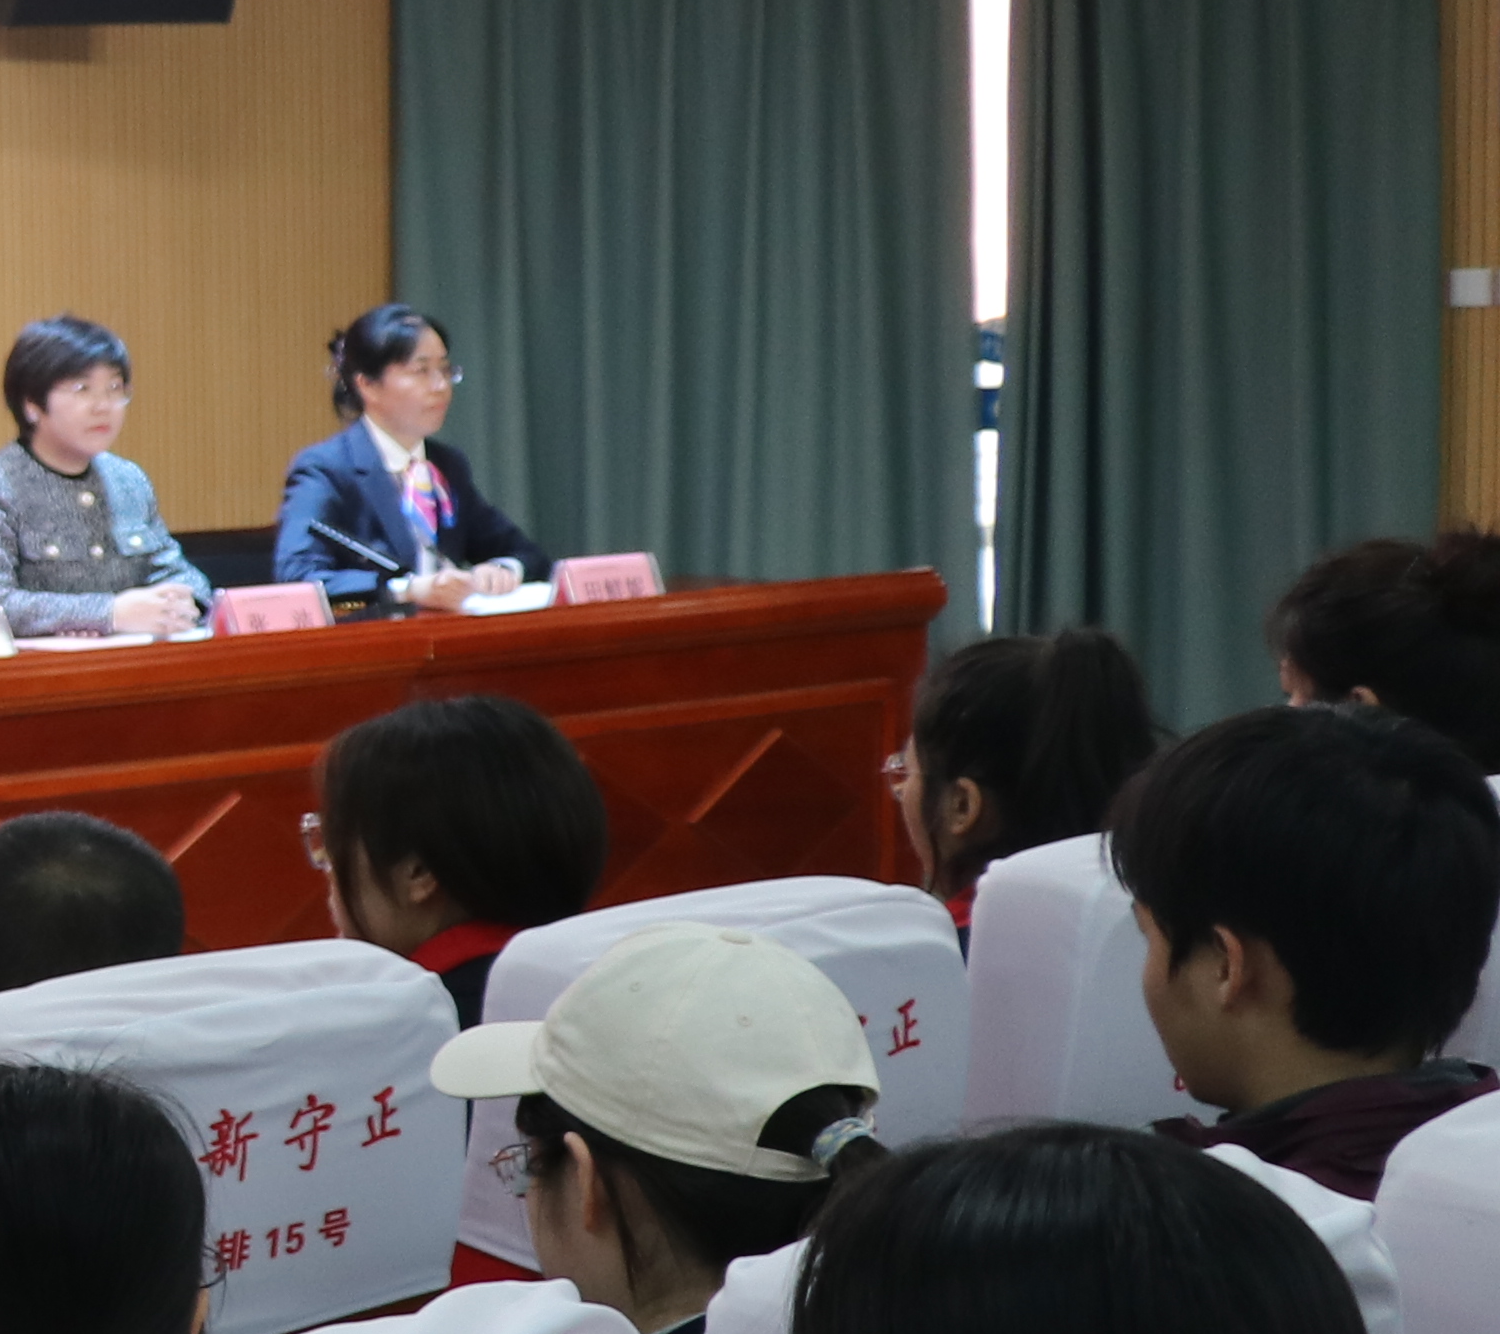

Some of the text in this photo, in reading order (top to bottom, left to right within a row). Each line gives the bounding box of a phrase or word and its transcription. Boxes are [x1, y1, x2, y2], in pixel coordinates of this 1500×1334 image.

[198, 1085, 402, 1182] 新守正
[214, 1207, 351, 1273] 排15号
